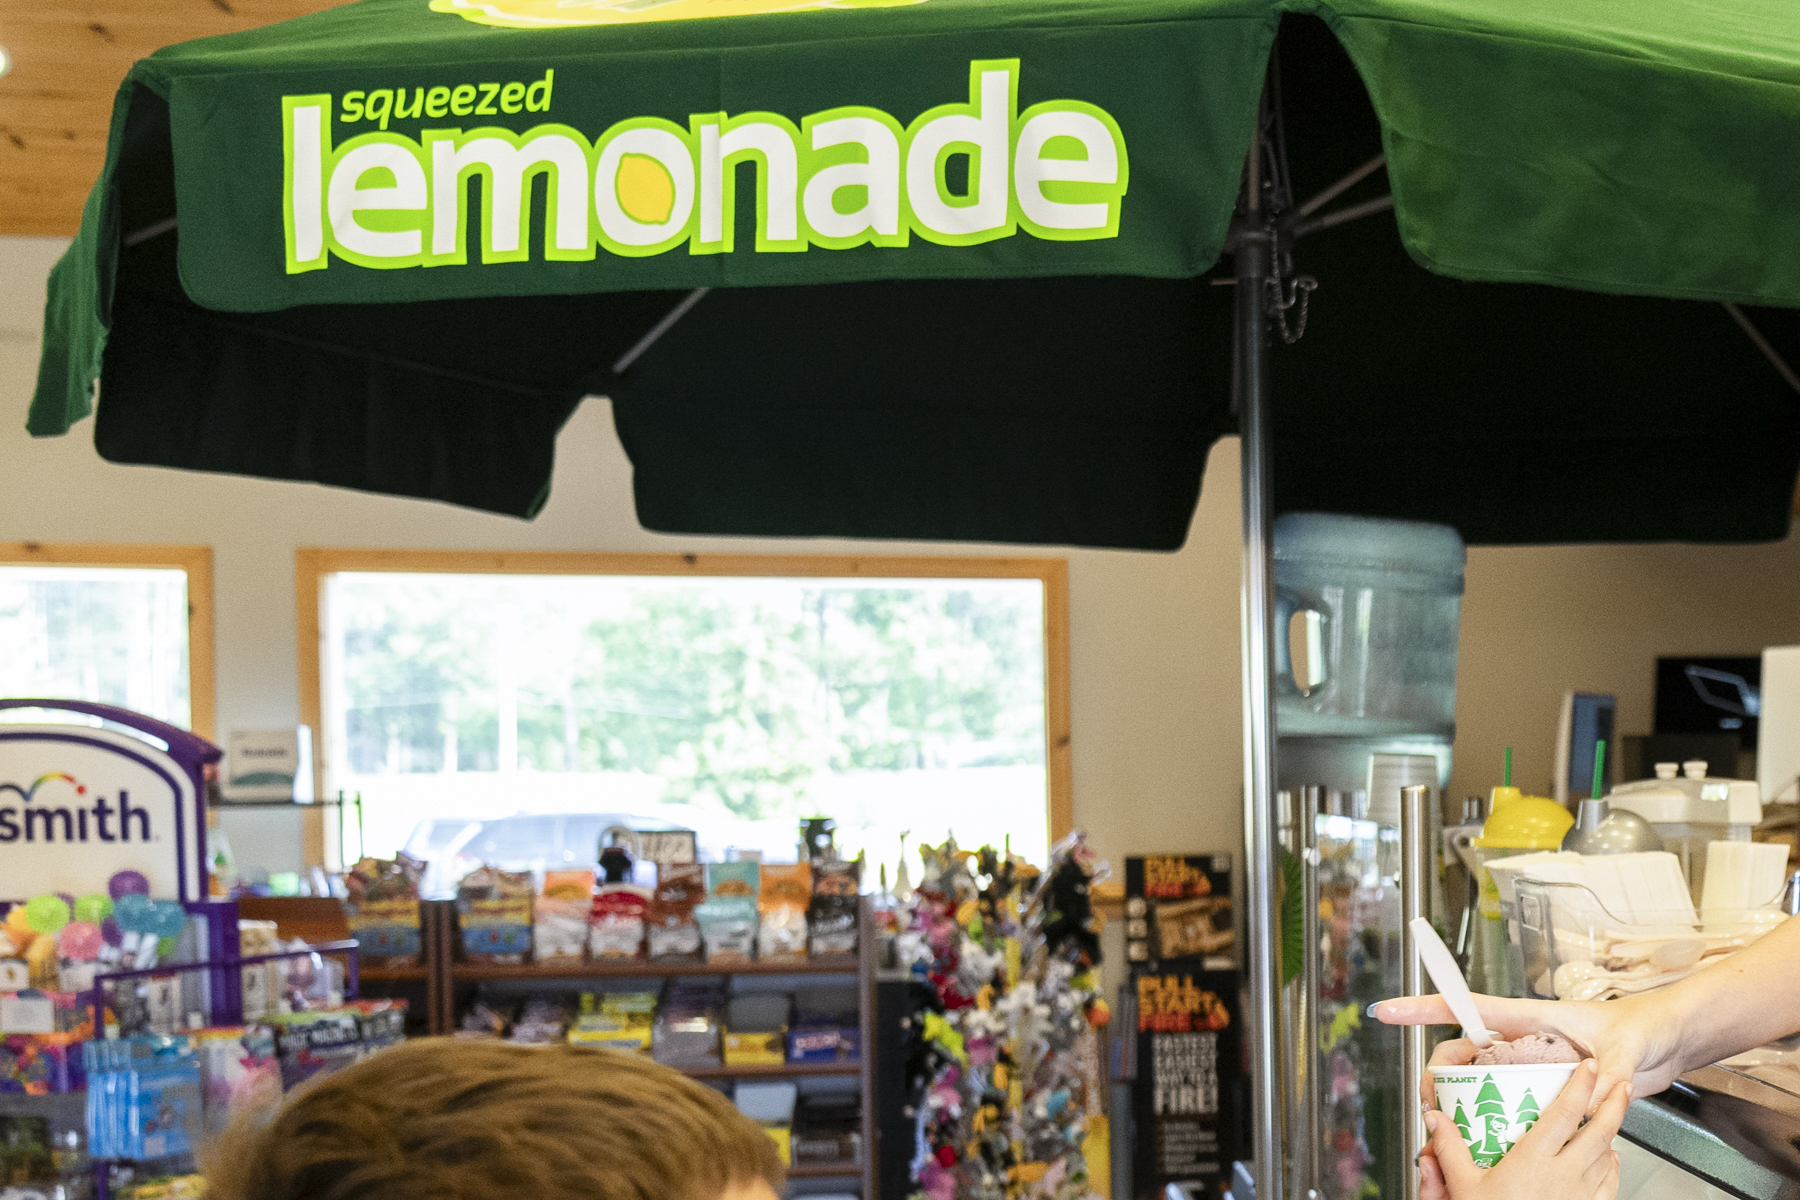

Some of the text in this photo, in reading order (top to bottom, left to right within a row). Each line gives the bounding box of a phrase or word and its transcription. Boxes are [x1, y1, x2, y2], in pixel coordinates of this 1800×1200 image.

[340, 68, 554, 130] squeezed
[282, 57, 1130, 274] lemonade
[1447, 1076, 1478, 1084] PLANET
